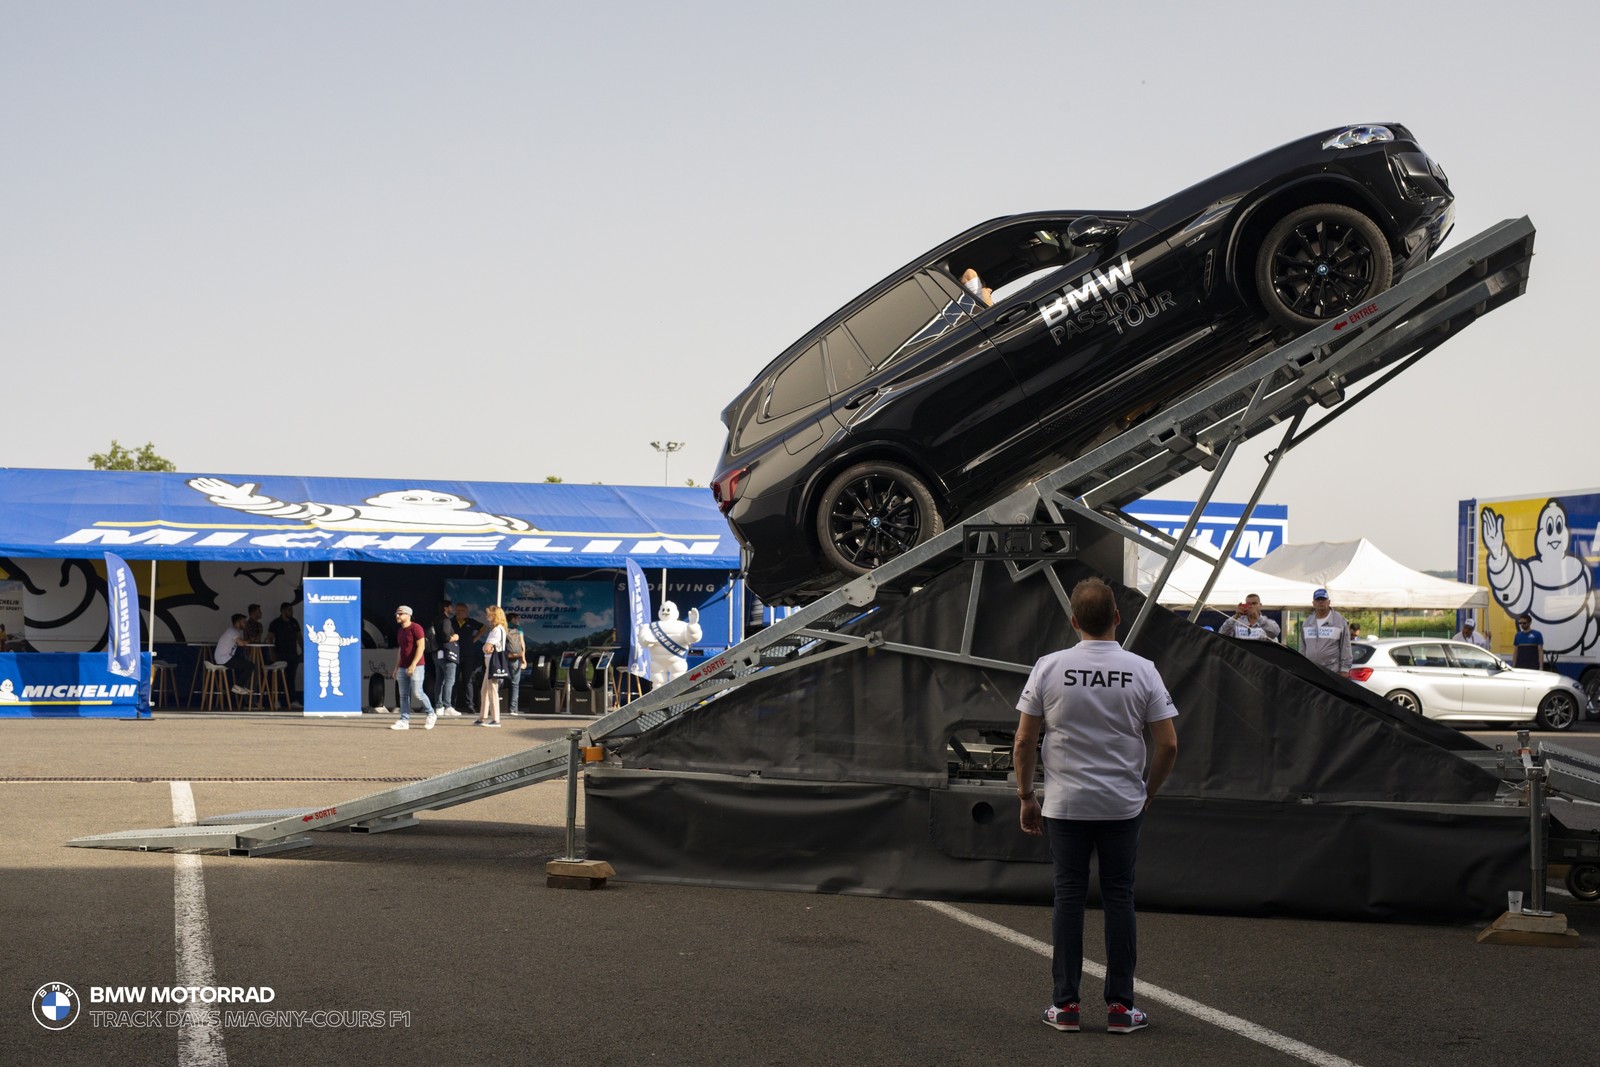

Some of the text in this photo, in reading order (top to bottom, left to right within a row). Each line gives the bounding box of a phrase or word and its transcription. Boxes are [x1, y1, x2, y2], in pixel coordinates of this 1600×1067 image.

[1037, 253, 1133, 328] BMW
[1050, 281, 1149, 346] PASSION
[1107, 290, 1177, 335] TOUR
[1348, 303, 1379, 324] ENTREE
[54, 528, 720, 555] MICHELIN
[116, 566, 131, 656] MICHELIN
[651, 622, 687, 656] MICHELIN
[702, 657, 727, 675] SORTIE
[1064, 669, 1133, 688] STAFF
[21, 684, 137, 698] MICHELIN
[315, 807, 337, 819] SORTIE
